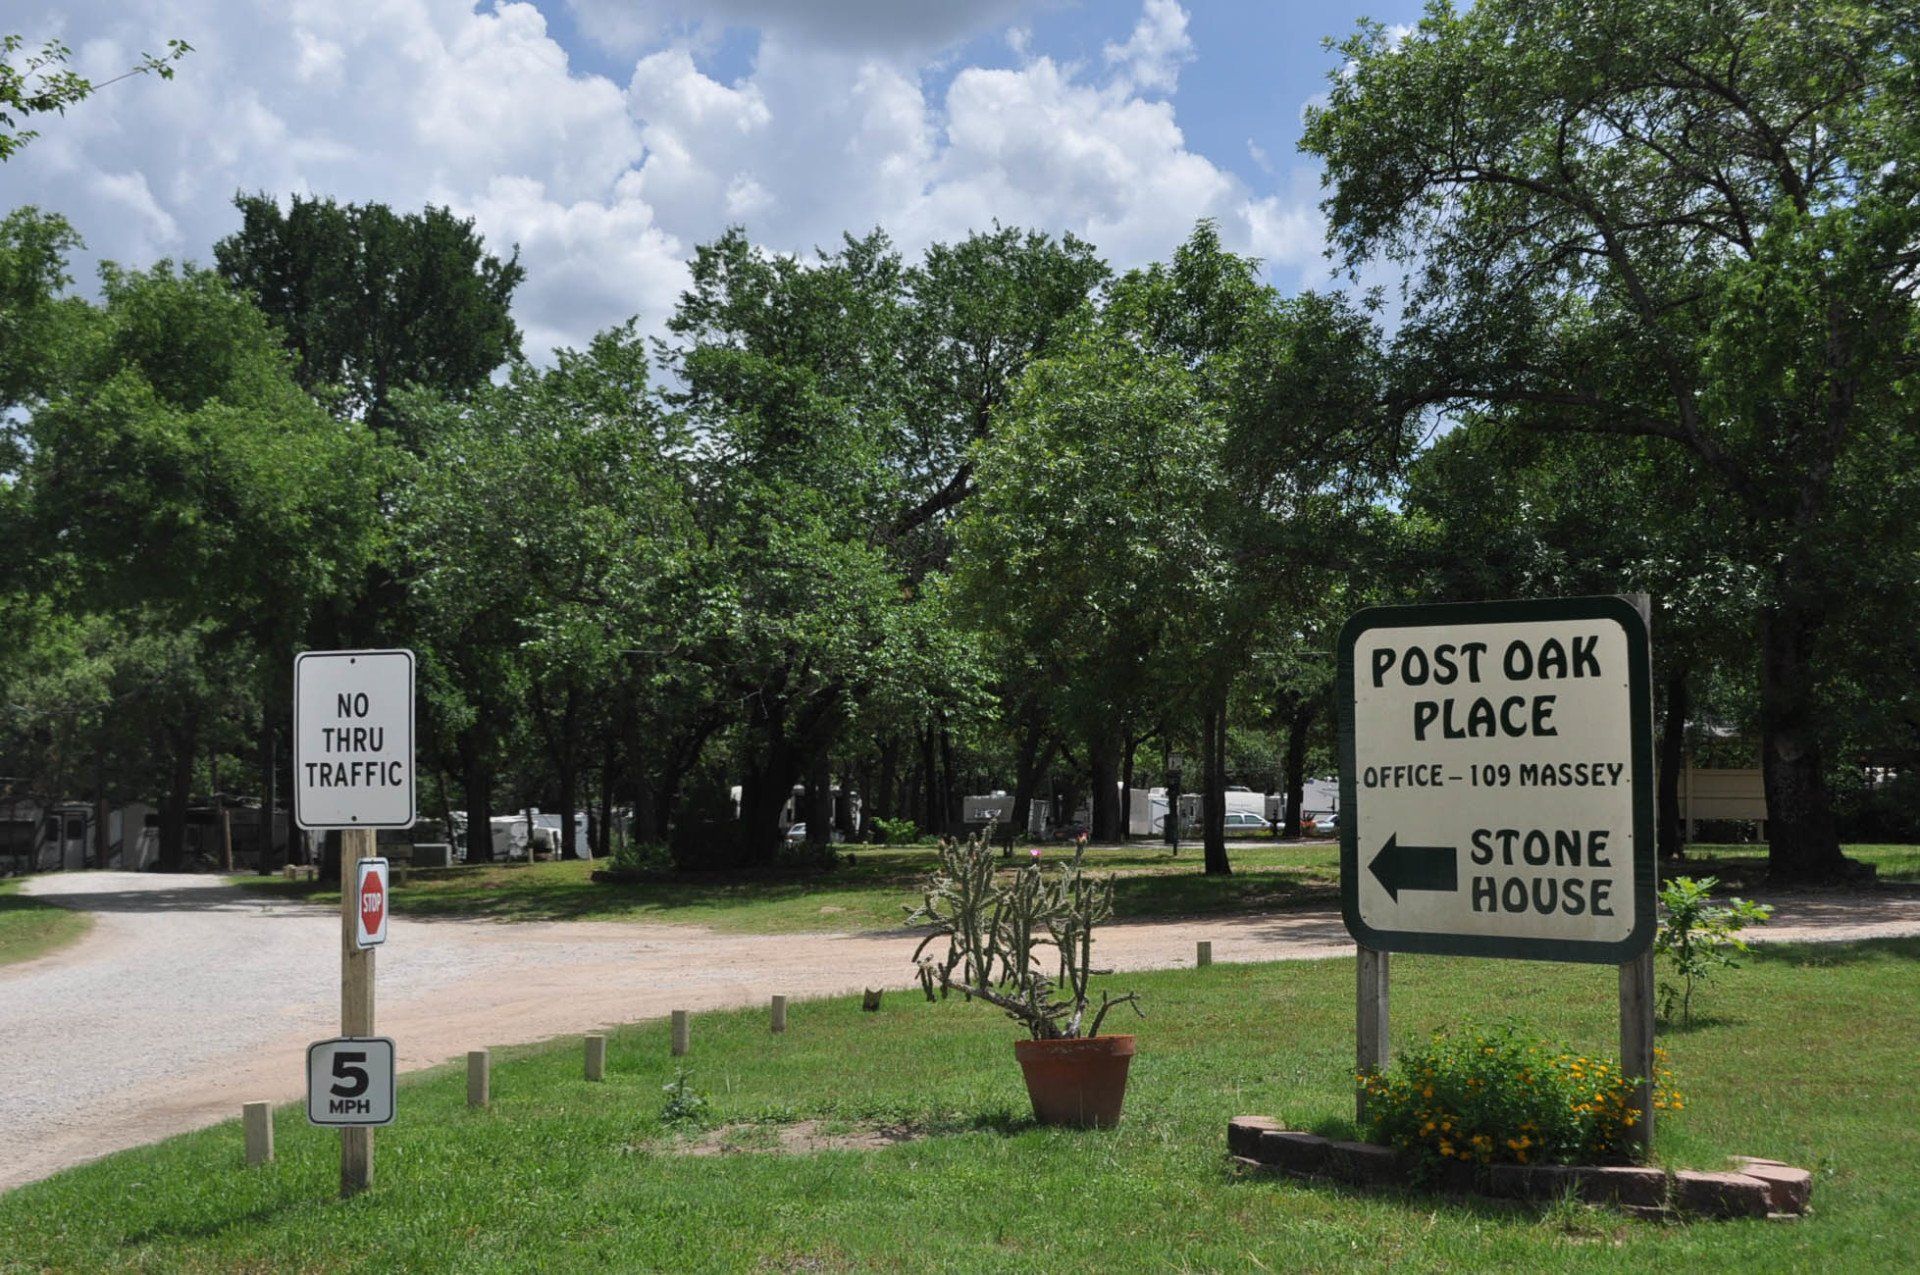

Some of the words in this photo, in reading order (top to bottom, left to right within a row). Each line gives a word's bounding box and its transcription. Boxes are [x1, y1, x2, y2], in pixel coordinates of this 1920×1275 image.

[1372, 642, 1488, 688] POST
[1503, 635, 1602, 681] OAK
[337, 692, 369, 718] NO
[1414, 695, 1558, 741] PLACE
[322, 727, 384, 752] THRU
[306, 761, 402, 787] TRAFFIC
[1363, 764, 1443, 788] OFFICE
[1471, 764, 1511, 787] 109
[1519, 763, 1624, 787] MASSEY
[1470, 829, 1611, 868] STONE
[362, 892, 382, 914] STOP
[1471, 876, 1614, 916] HOUSE
[329, 1052, 369, 1097] 5
[329, 1098, 370, 1114] MPH
